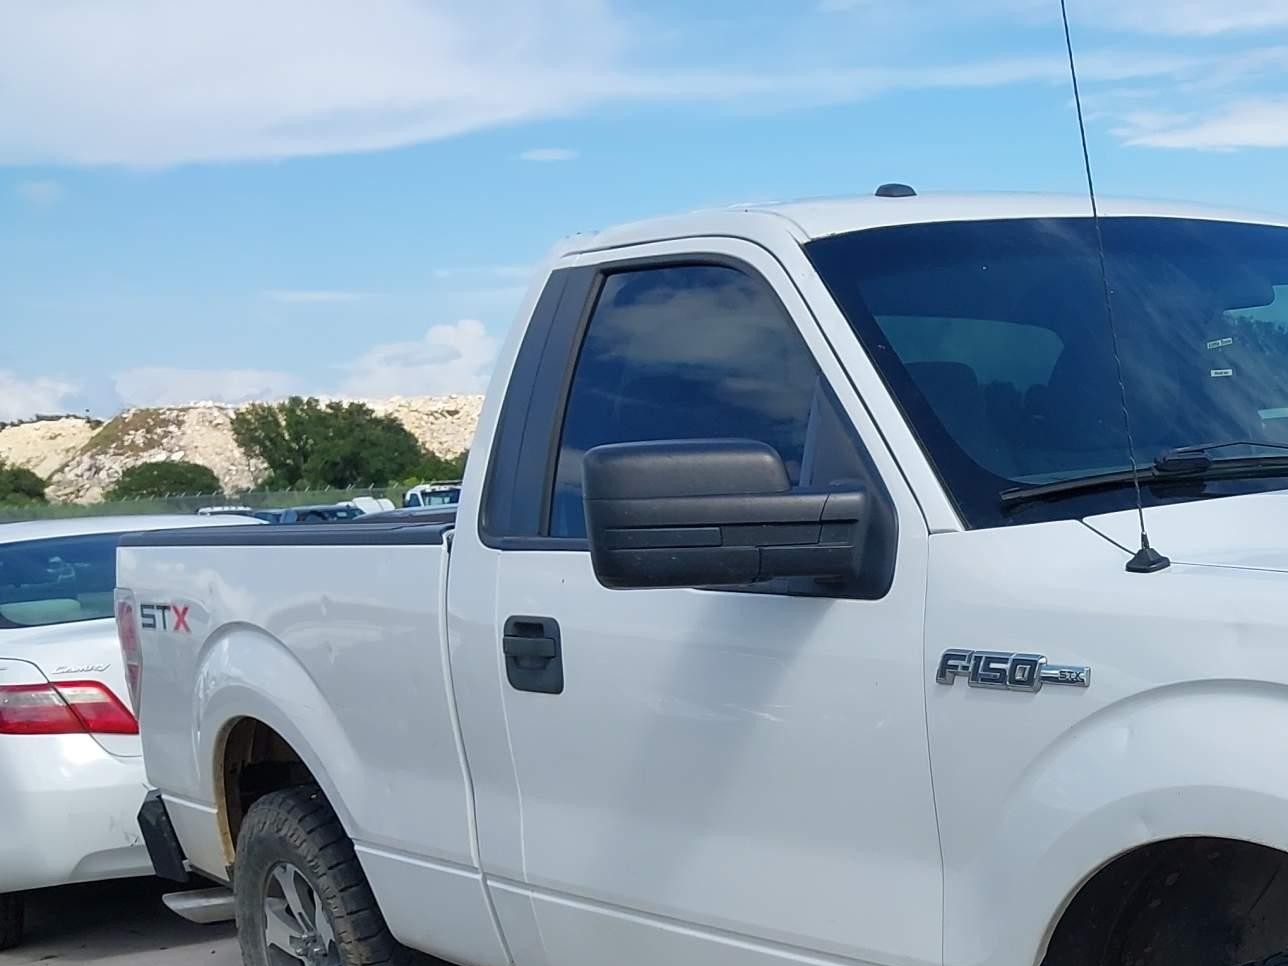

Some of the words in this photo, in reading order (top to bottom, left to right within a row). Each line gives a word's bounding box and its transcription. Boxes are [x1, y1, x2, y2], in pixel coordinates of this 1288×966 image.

[140, 604, 191, 633] STX
[936, 649, 1047, 693] F-150
[1058, 670, 1083, 682] STX
